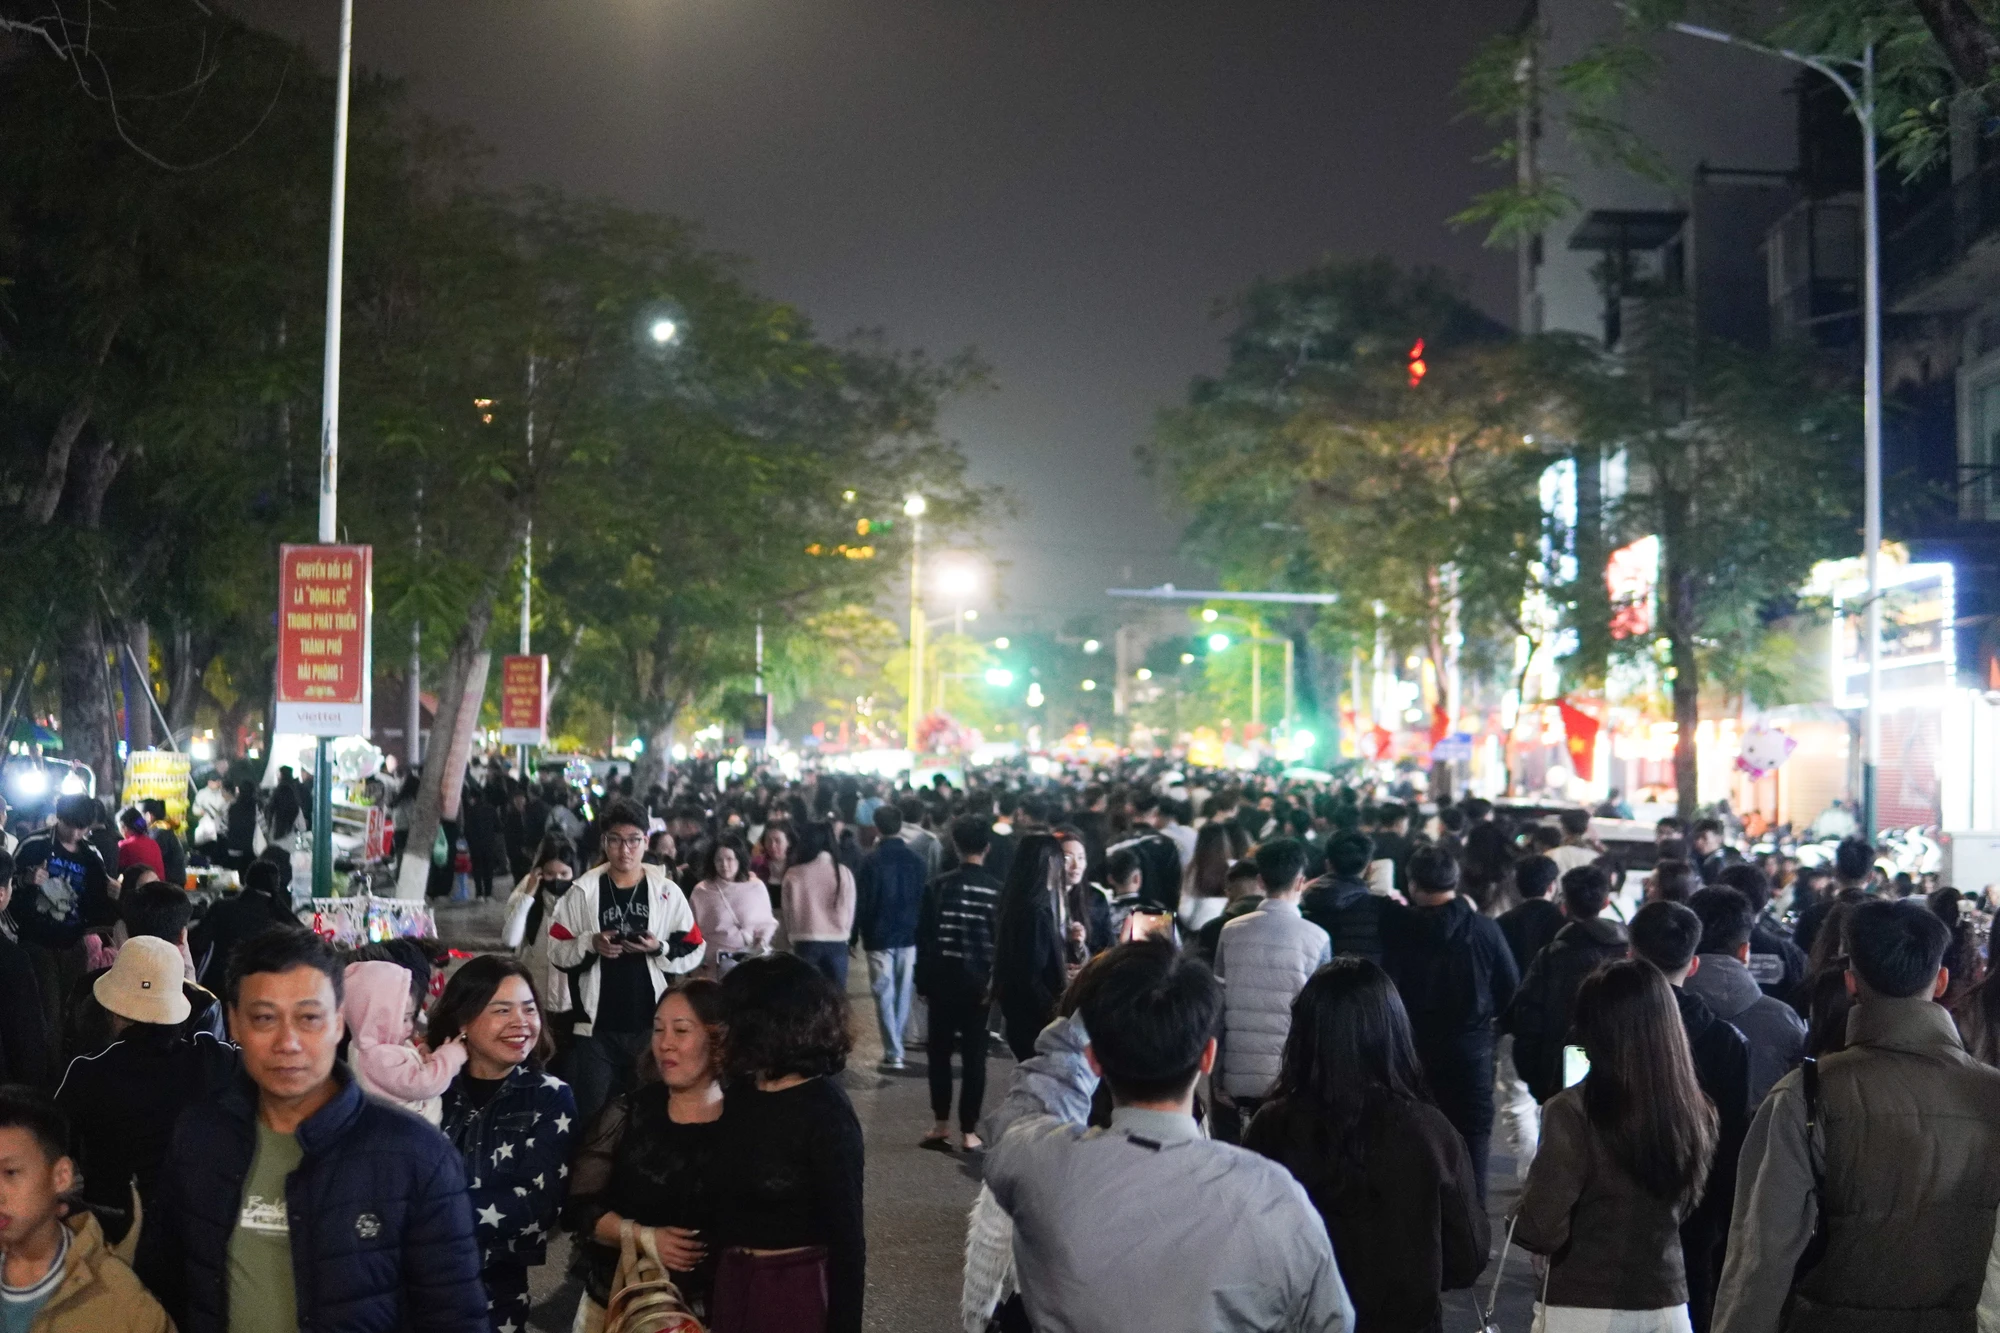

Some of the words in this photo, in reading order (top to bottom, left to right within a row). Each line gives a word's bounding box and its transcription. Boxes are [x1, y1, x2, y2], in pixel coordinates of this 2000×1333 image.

[287, 612, 312, 631] TRONG
[313, 610, 333, 631] PHÁT
[300, 635, 325, 656] THÀNH
[327, 634, 343, 656] PHỐ
[312, 660, 338, 681] PHÒNG
[296, 712, 341, 722] viettel
